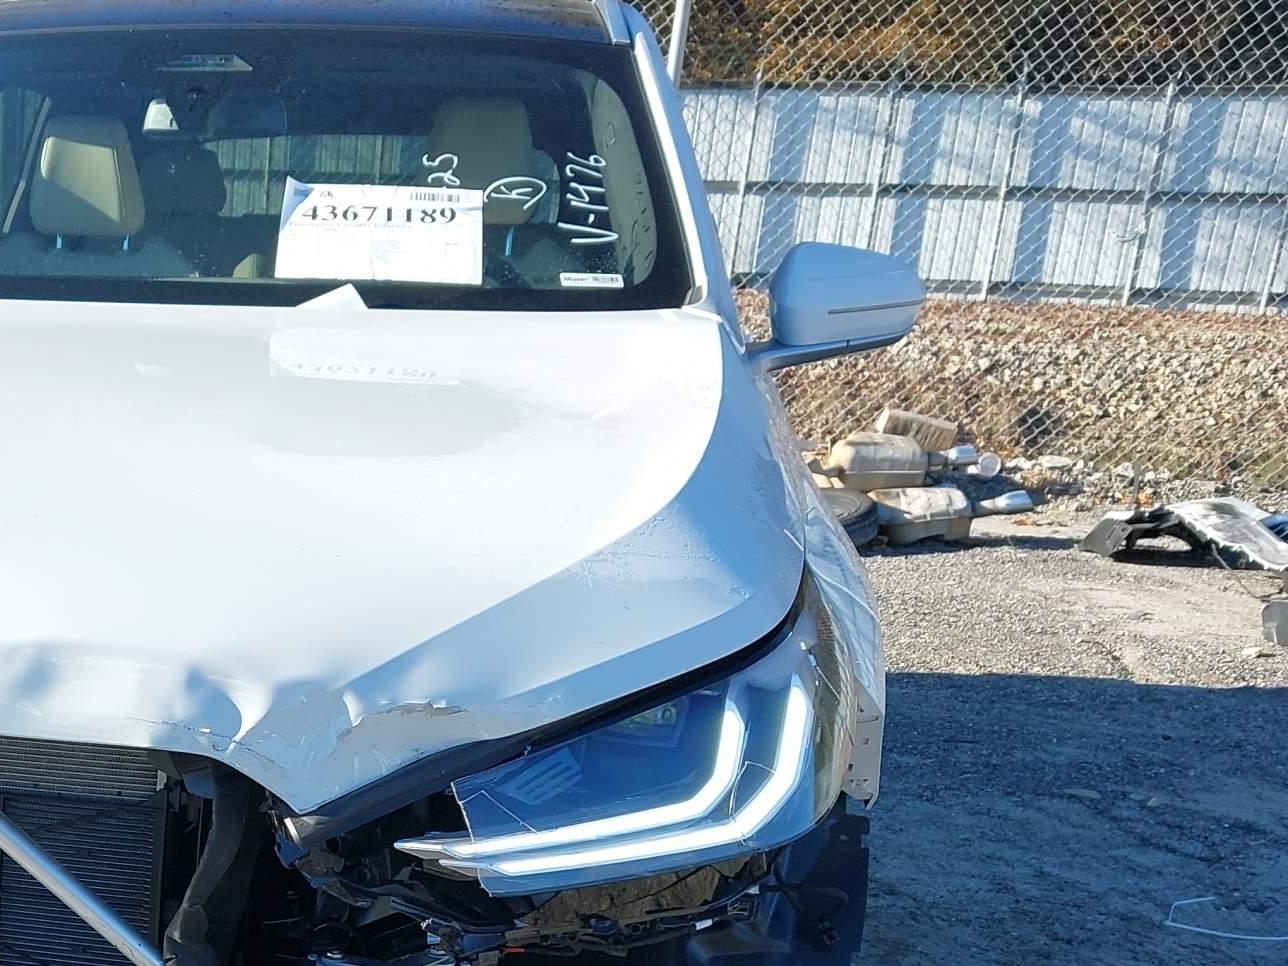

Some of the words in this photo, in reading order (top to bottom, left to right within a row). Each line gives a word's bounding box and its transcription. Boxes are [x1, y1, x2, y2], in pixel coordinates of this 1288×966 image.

[421, 152, 461, 186] 25
[302, 204, 458, 224] 43671189
[557, 151, 619, 244] V-1476
